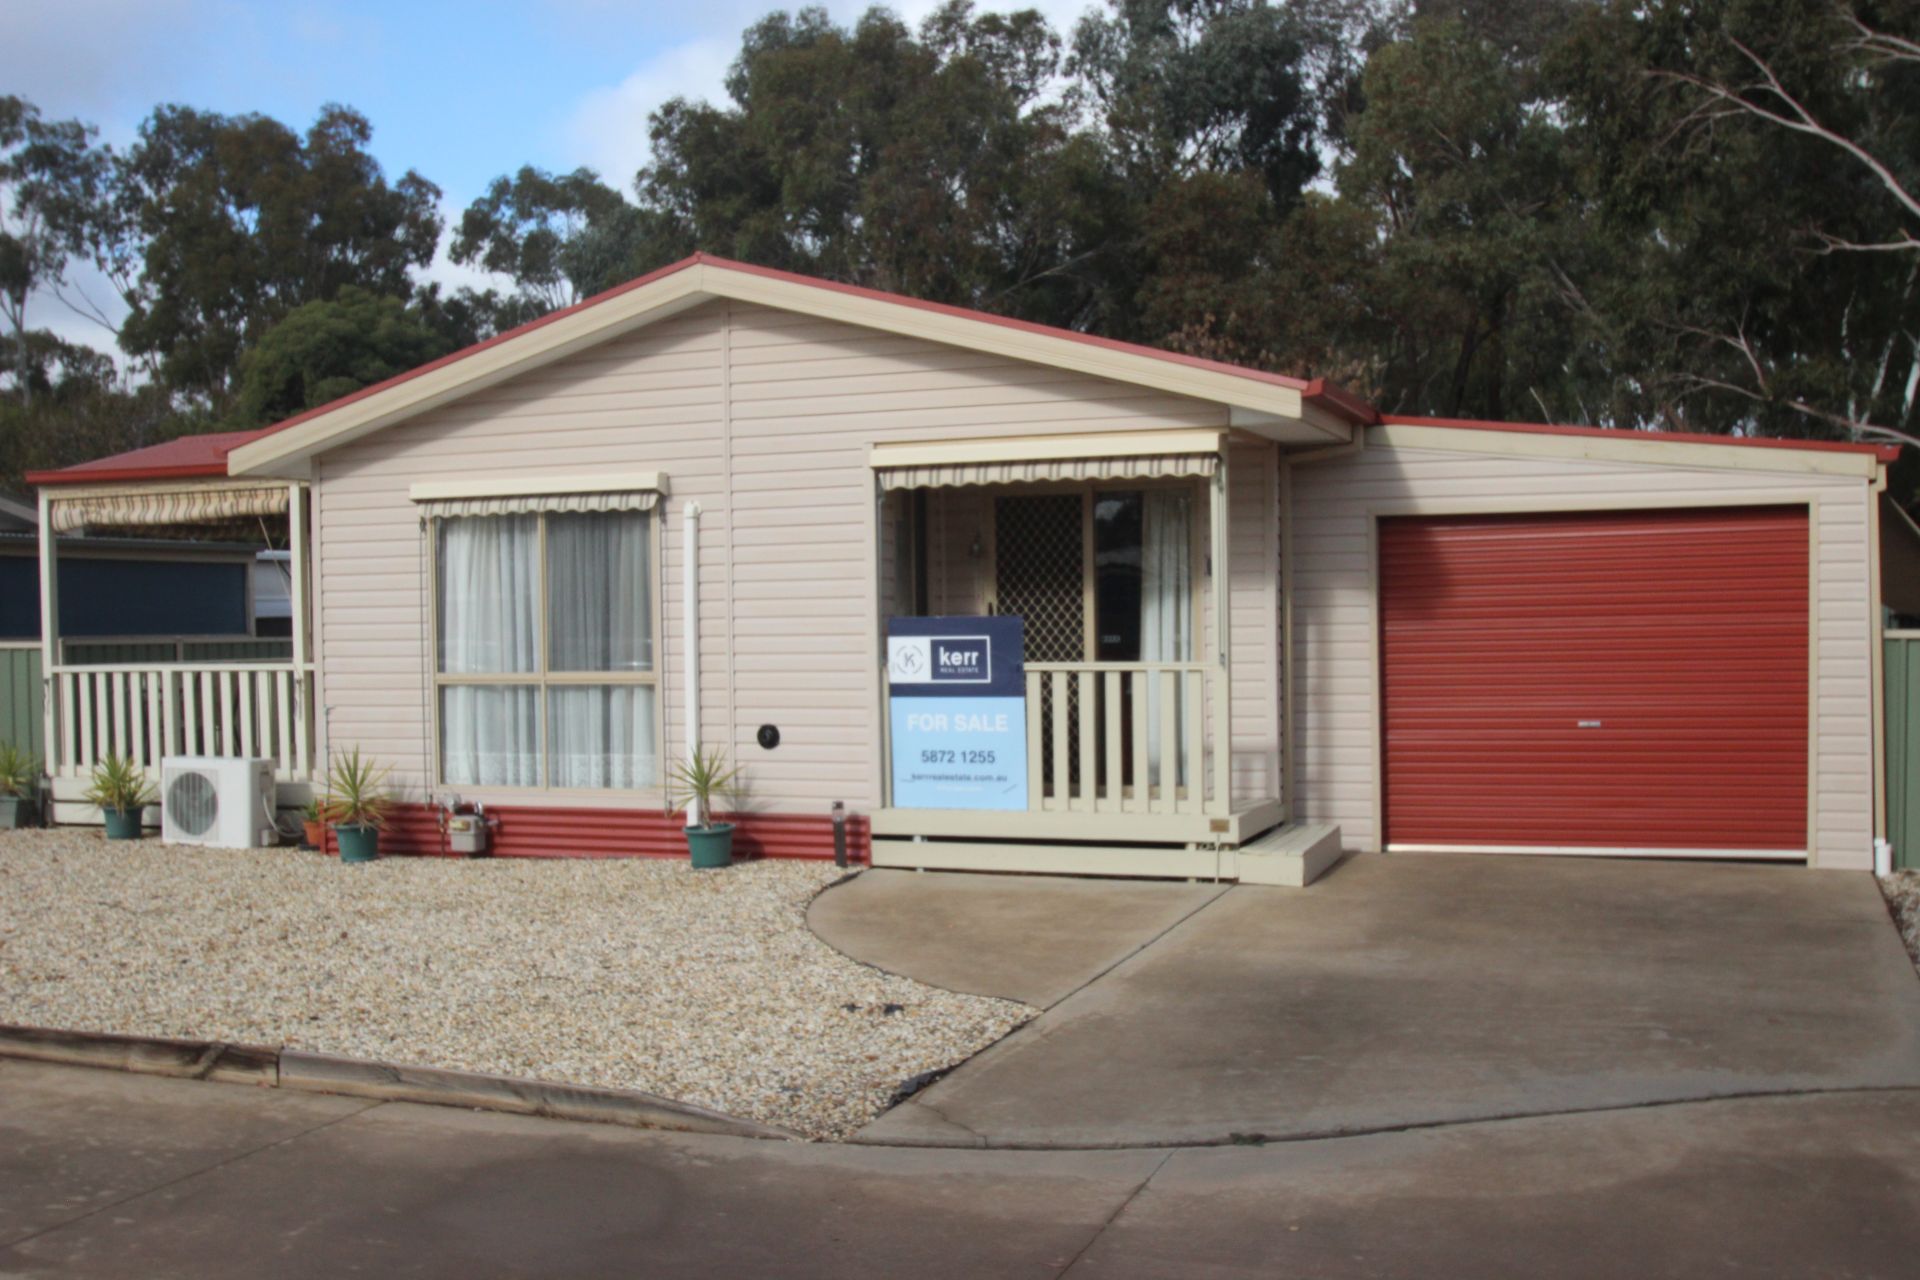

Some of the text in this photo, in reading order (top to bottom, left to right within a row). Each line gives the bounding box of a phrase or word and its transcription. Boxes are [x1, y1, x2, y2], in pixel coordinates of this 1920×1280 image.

[904, 652, 915, 667] K
[940, 646, 979, 666] kerr
[907, 714, 1008, 732] FOR SALE
[922, 750, 996, 764] 5872 1255
